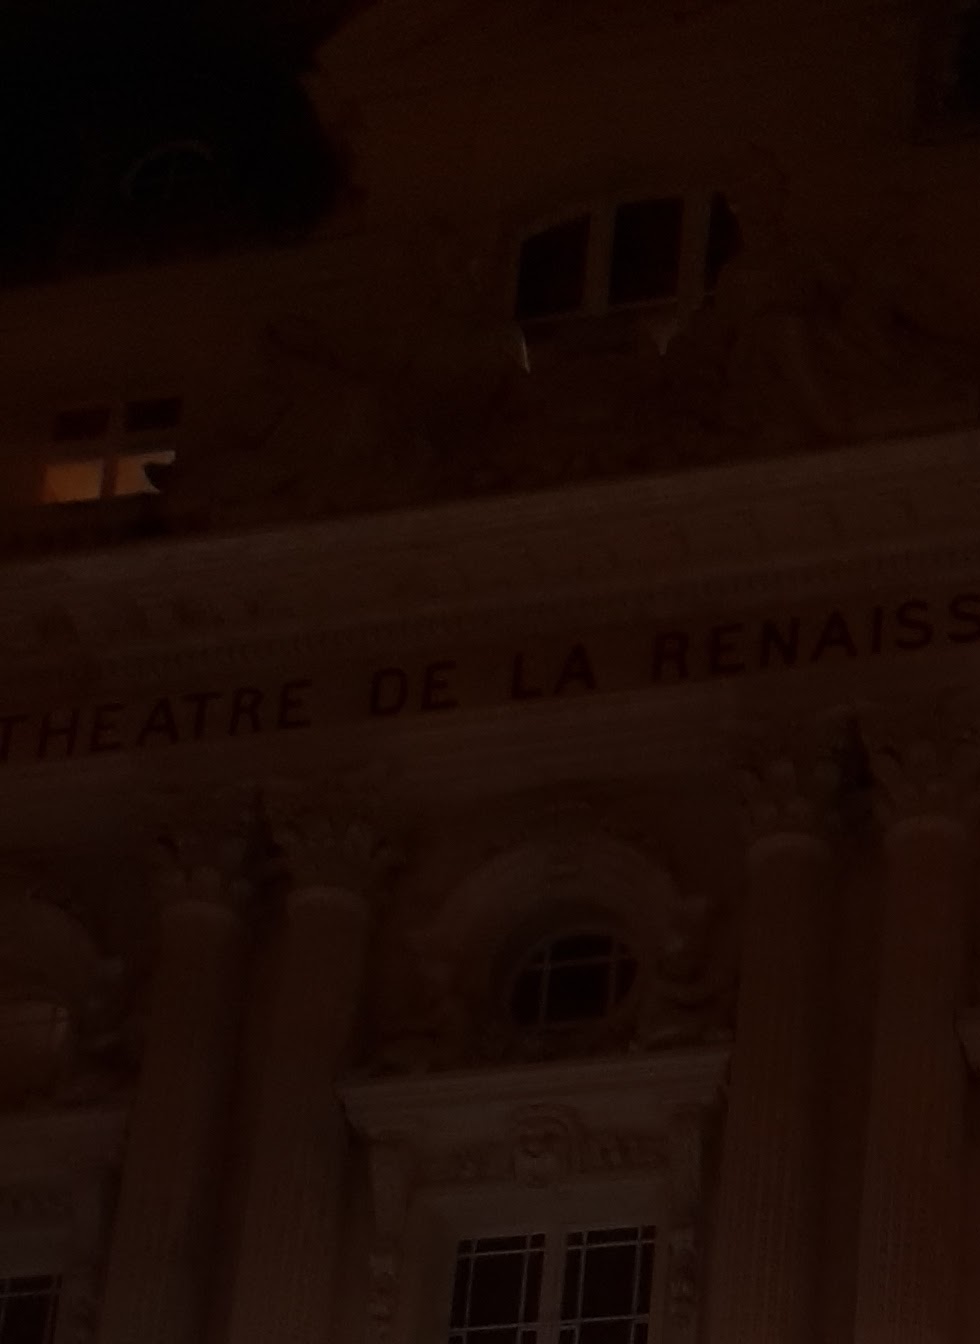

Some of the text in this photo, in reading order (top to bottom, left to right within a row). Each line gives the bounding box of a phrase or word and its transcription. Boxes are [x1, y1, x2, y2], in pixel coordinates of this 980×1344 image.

[0, 680, 314, 764] THEATRE
[369, 659, 460, 717] DE
[509, 643, 596, 701] LA
